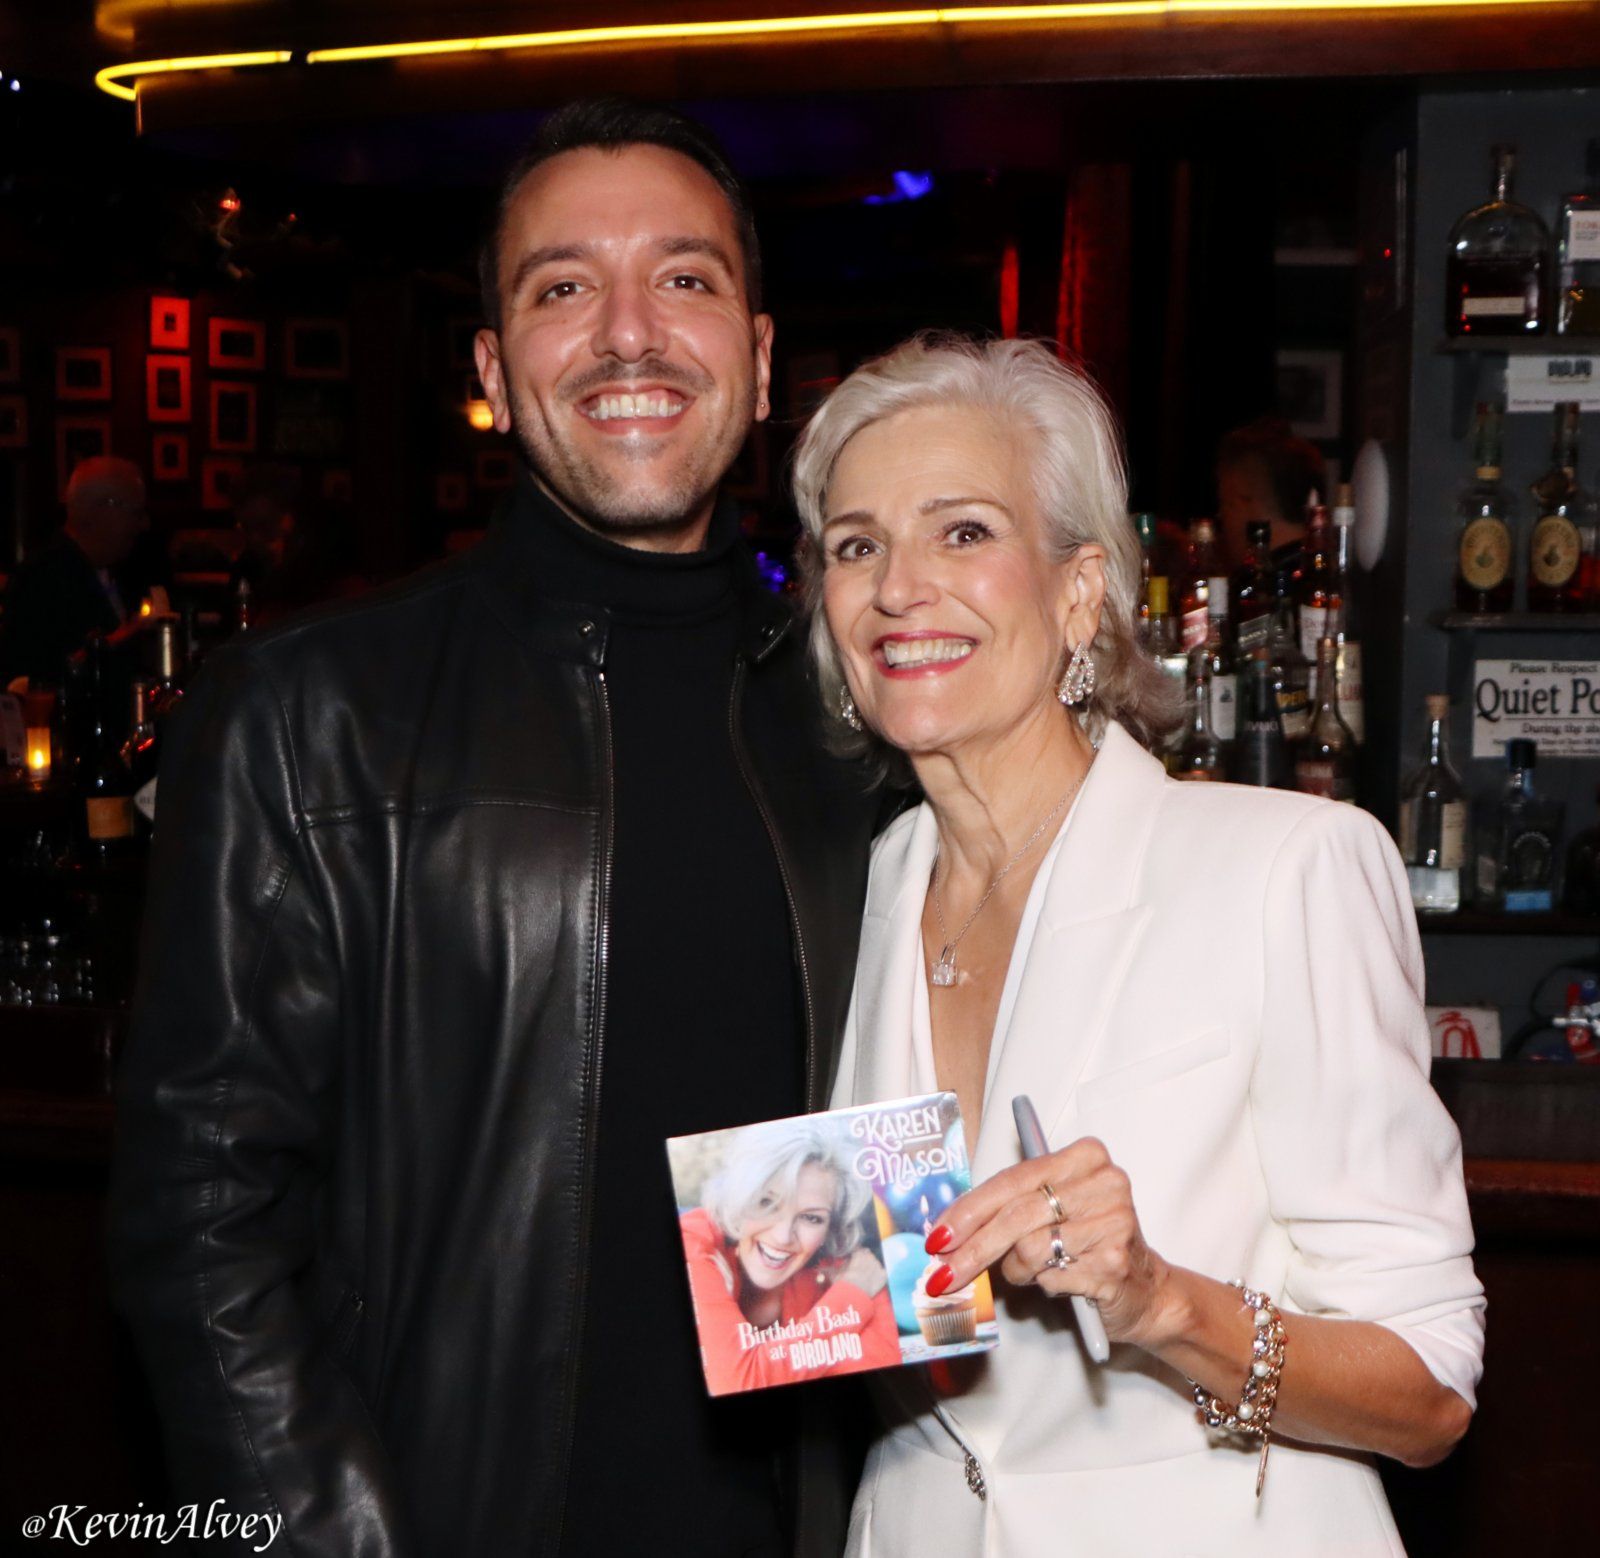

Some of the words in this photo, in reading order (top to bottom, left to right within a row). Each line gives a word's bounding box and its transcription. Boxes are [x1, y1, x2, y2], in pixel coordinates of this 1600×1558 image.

[1509, 662, 1547, 673] Please
[1551, 662, 1598, 675] Respect
[1476, 678, 1560, 723] Quiet
[1522, 722, 1560, 735] During
[851, 1106, 943, 1152] KAREN
[853, 1146, 965, 1192] MASON
[736, 1316, 815, 1351] Birthday
[815, 1303, 862, 1335] Bash
[769, 1343, 788, 1361] at
[788, 1331, 863, 1371] BIRDLAND
